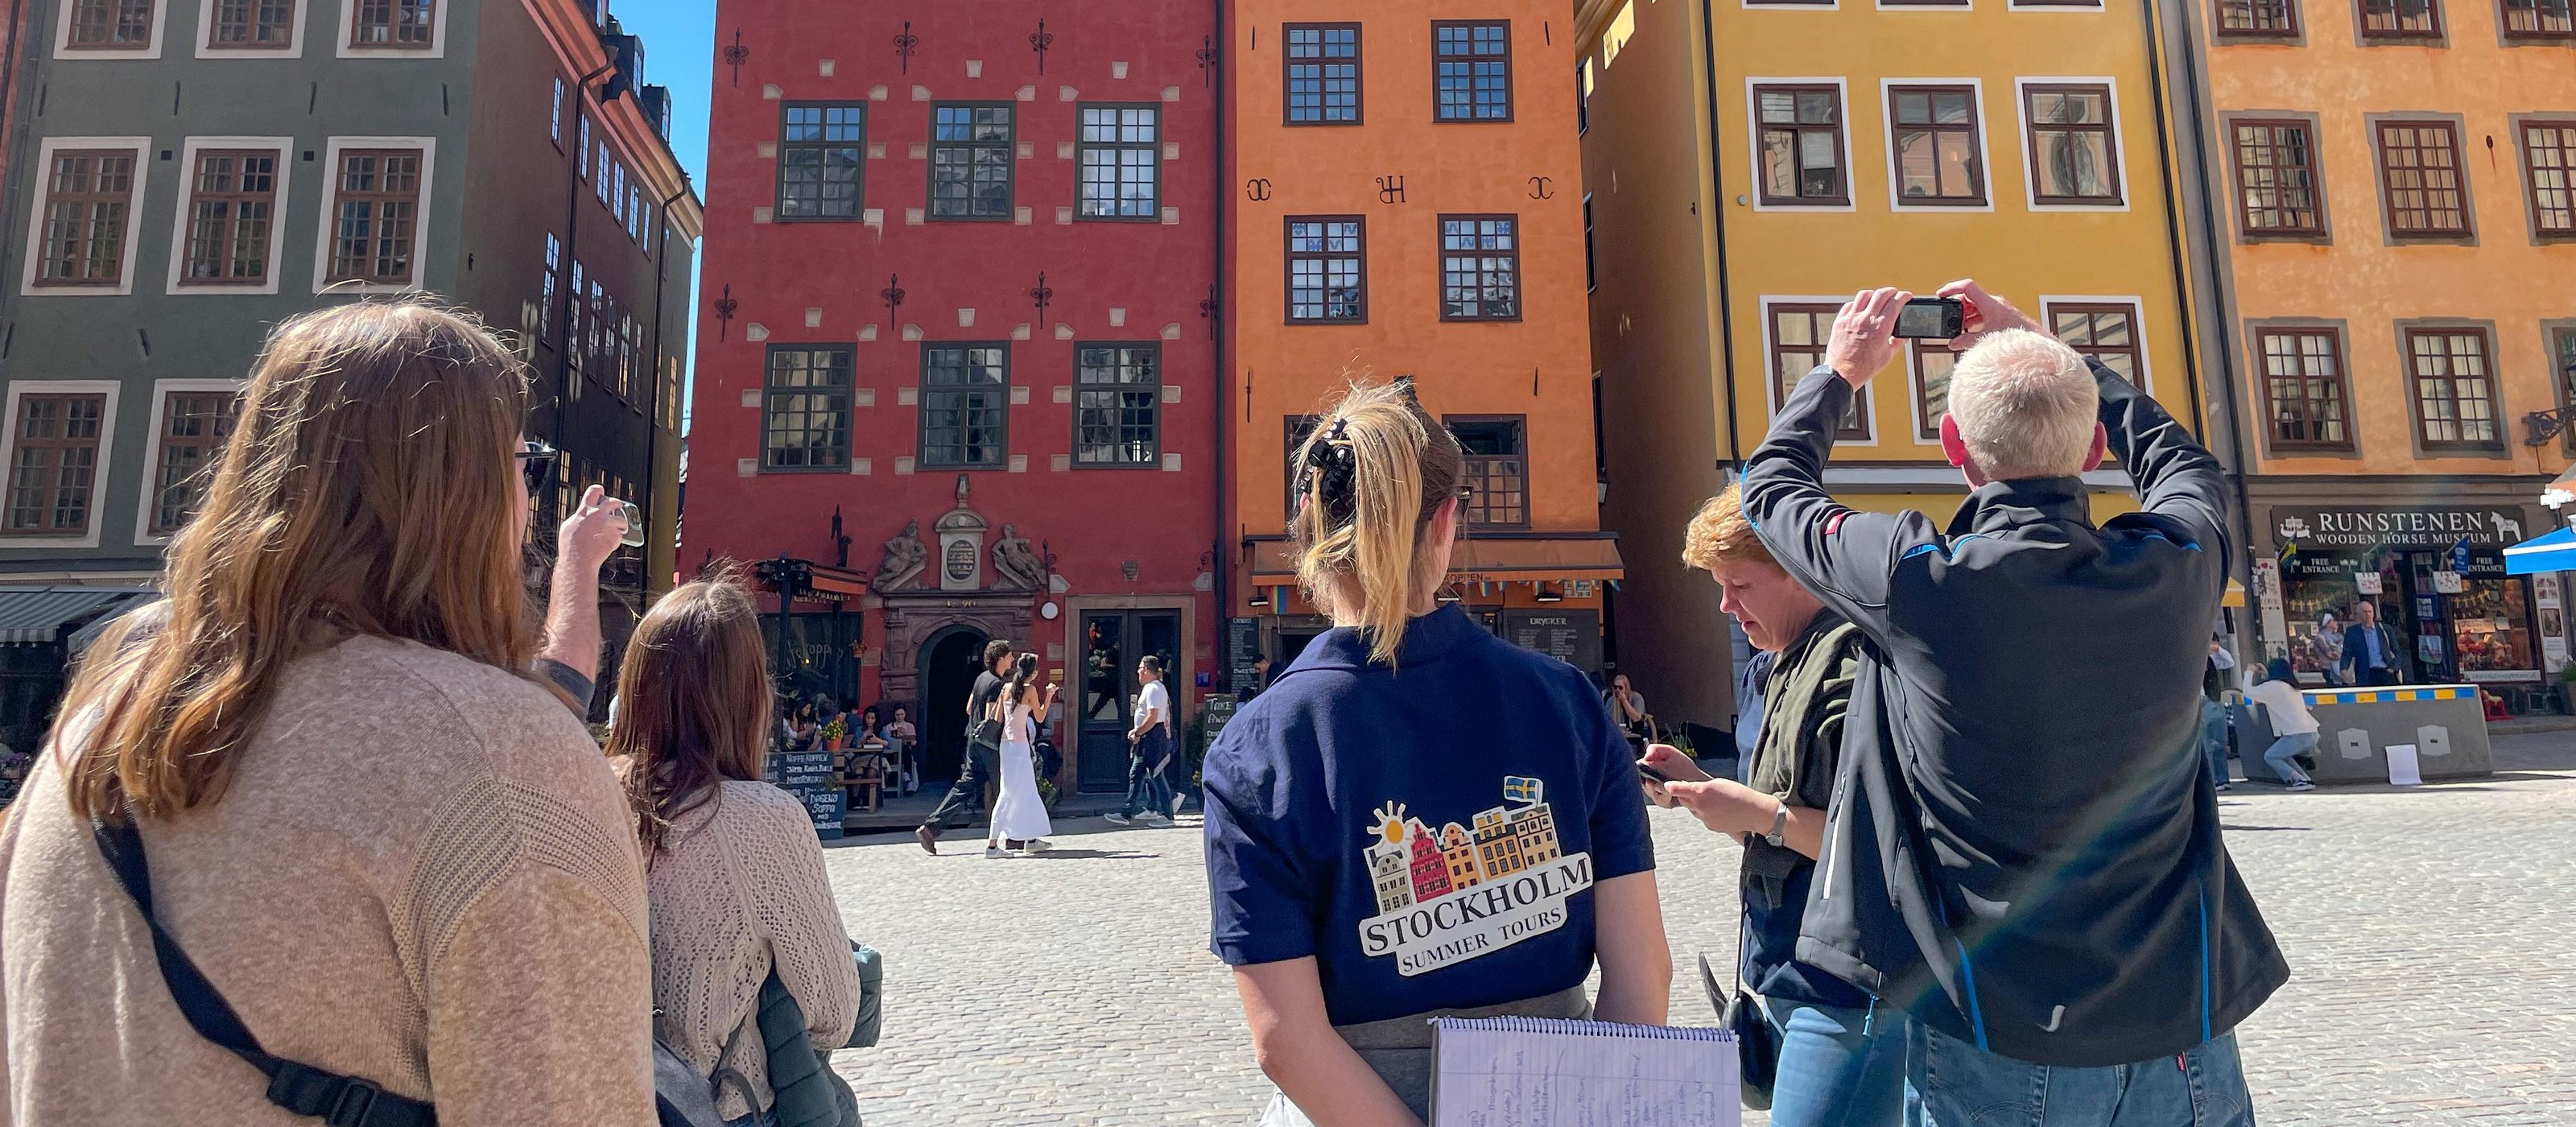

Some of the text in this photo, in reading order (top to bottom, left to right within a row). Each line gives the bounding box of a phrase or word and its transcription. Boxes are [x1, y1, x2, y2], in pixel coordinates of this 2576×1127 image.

[2318, 512, 2482, 532] RUNSTENEN
[2316, 534, 2376, 544] WOODEN
[2382, 533, 2426, 544] HORSE
[2302, 565, 2340, 573] ENTRANCE
[2311, 558, 2330, 566] FREE
[1207, 697, 1232, 711] TAKE
[1366, 857, 1591, 952] STOCKHOLM
[1402, 907, 1562, 972] SUMMER TOURS
